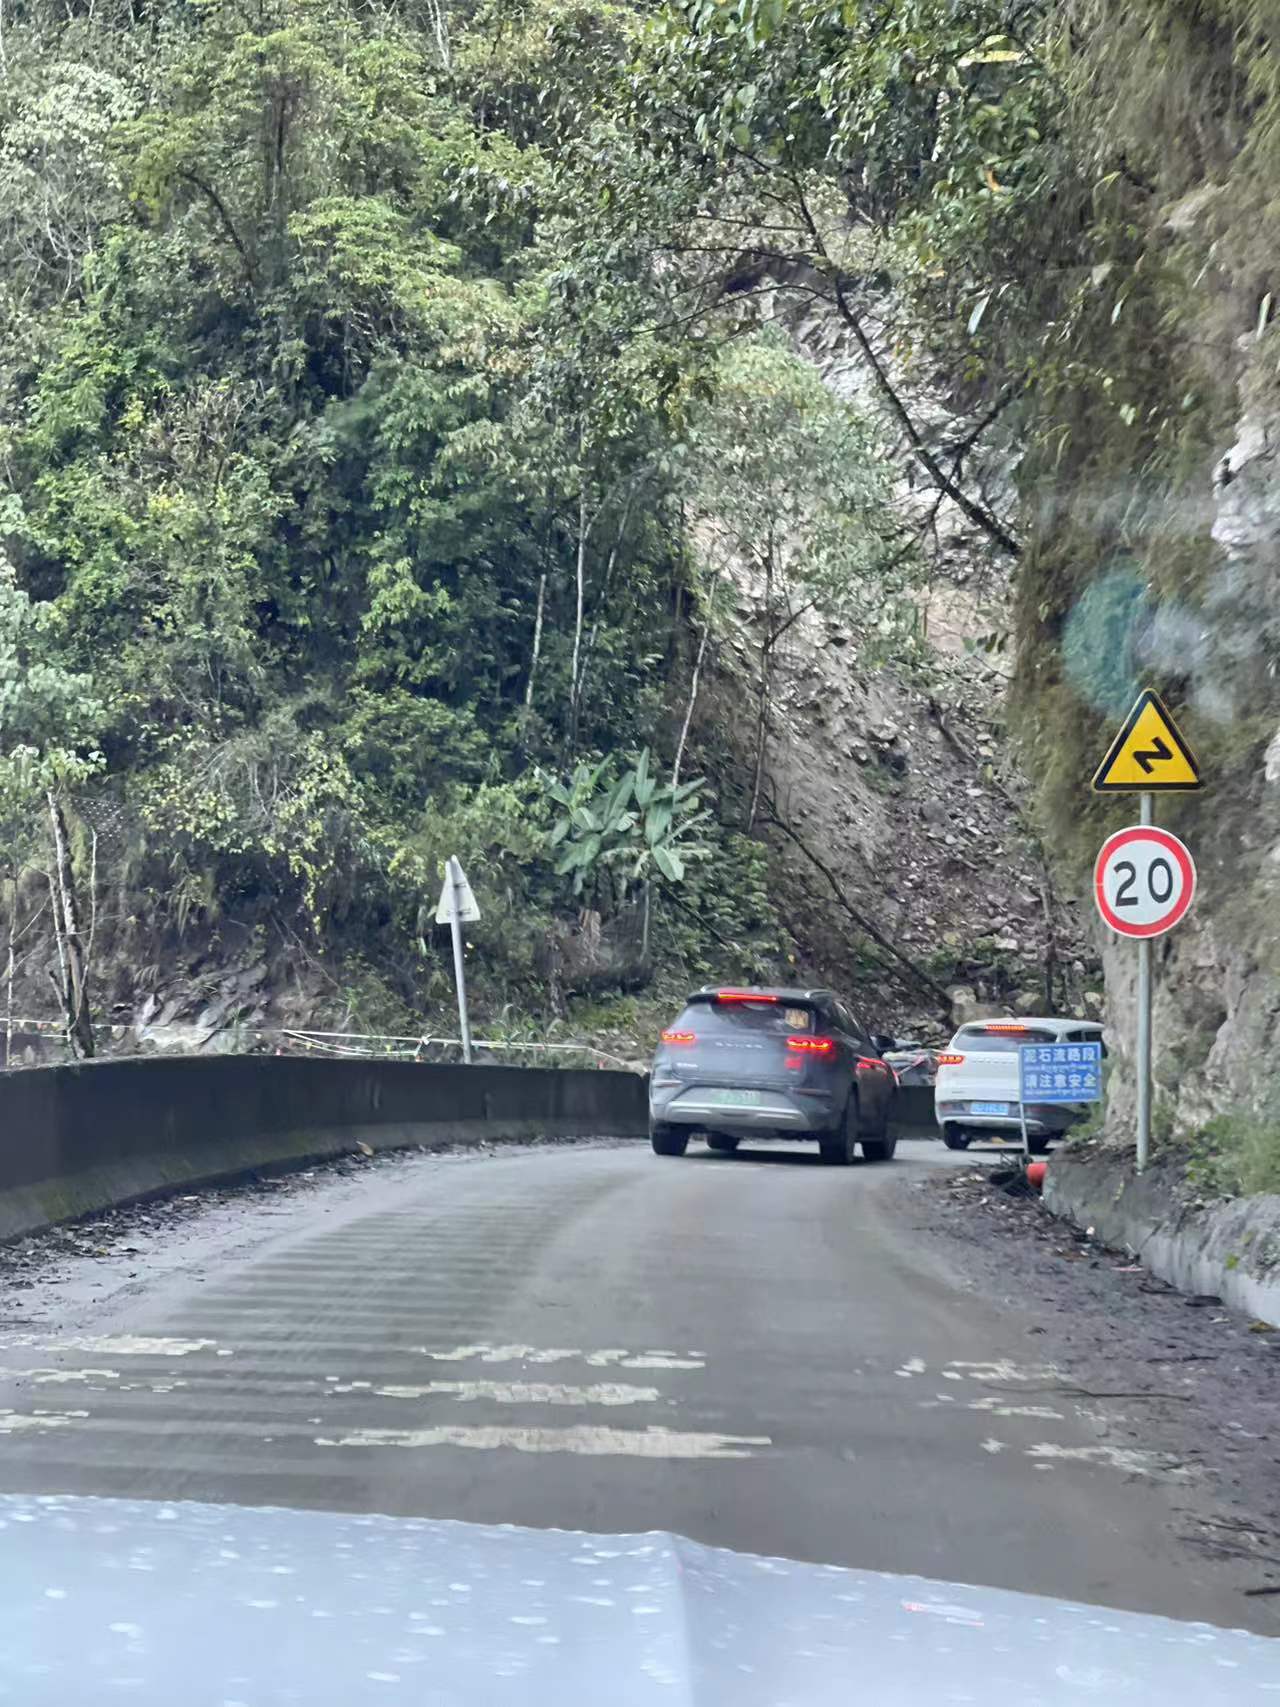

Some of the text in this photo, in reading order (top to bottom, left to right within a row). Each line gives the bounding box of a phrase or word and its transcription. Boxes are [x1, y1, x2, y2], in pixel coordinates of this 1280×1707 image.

[1113, 857, 1173, 907] 20
[1023, 1047, 1096, 1063] 泥石流路段
[1025, 1072, 1097, 1089] 请注意安全
